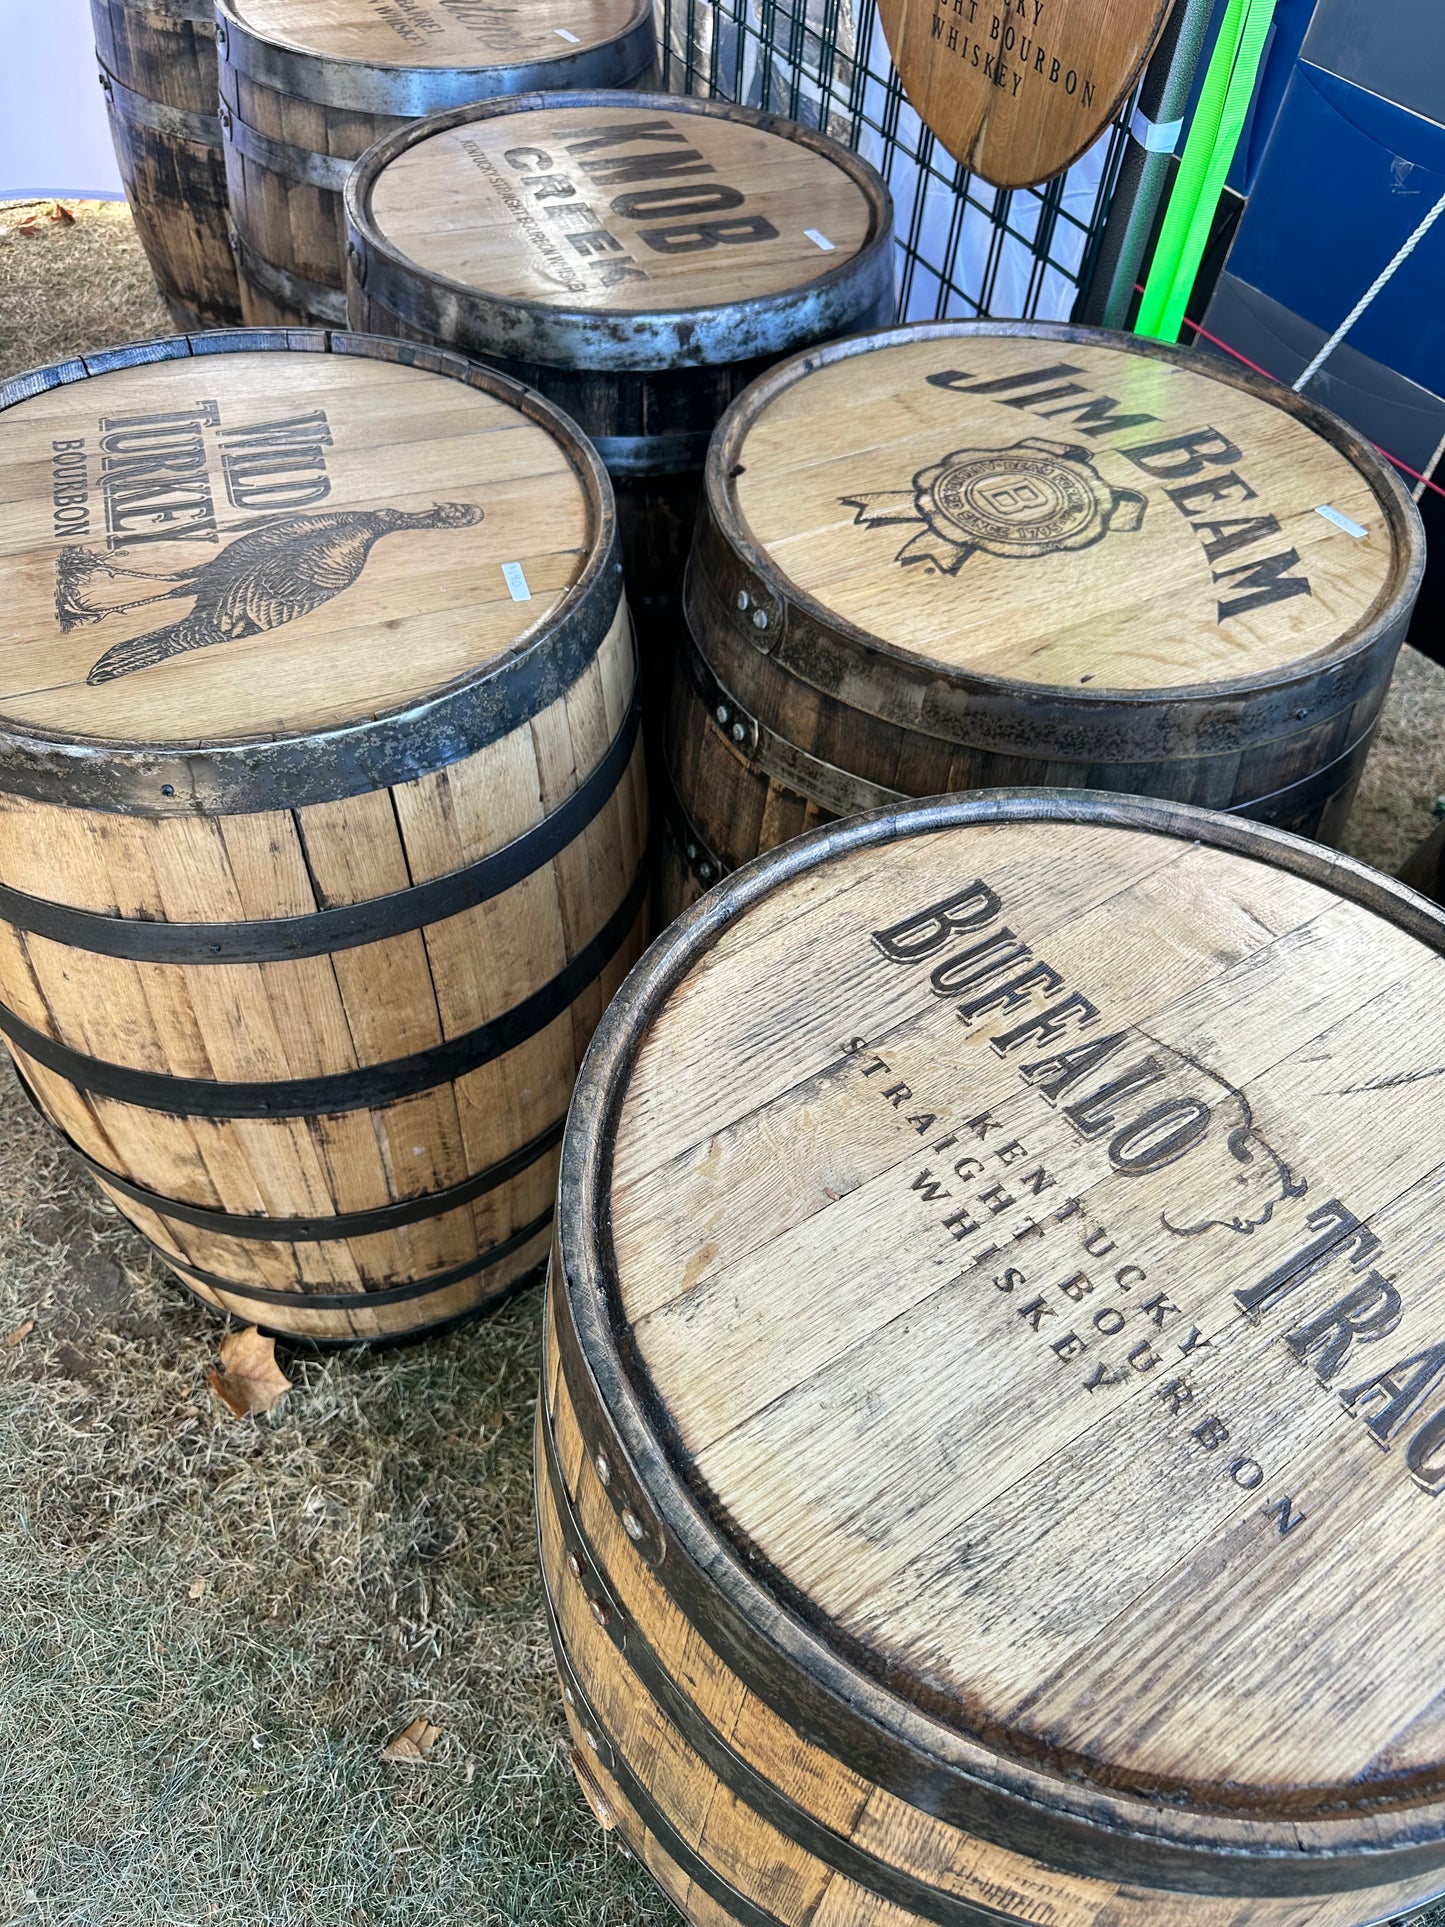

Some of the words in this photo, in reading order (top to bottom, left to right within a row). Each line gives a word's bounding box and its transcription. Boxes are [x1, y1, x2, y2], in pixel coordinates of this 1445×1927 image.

[374, 5, 431, 49] WHISKEY
[931, 14, 1022, 97] WHISKEY
[990, 15, 1096, 108] BOURBON
[460, 139, 499, 182] KENTUCKY
[489, 169, 526, 222] STRAIGHT
[518, 214, 558, 259] BOURBON
[546, 249, 588, 293] WHISKEY
[504, 147, 651, 288] CREEK
[552, 121, 780, 254] KNOB
[52, 438, 90, 538] BOURBON
[98, 399, 220, 550] TURKEY
[216, 410, 334, 510] WILD
[926, 362, 1166, 440] JIM
[1118, 426, 1313, 625] BEAM
[957, 511, 1009, 539] SINCE
[1017, 524, 1062, 539] 1795
[978, 478, 1048, 515] B
[1052, 473, 1084, 521] FORMA
[872, 879, 1216, 1178] BUFFALO
[842, 1036, 1045, 1241] STRAIGHT
[1059, 1270, 1309, 1536] BOURBON
[908, 1167, 1112, 1394] WHISKEY
[969, 1113, 1216, 1340] KENTUCKY
